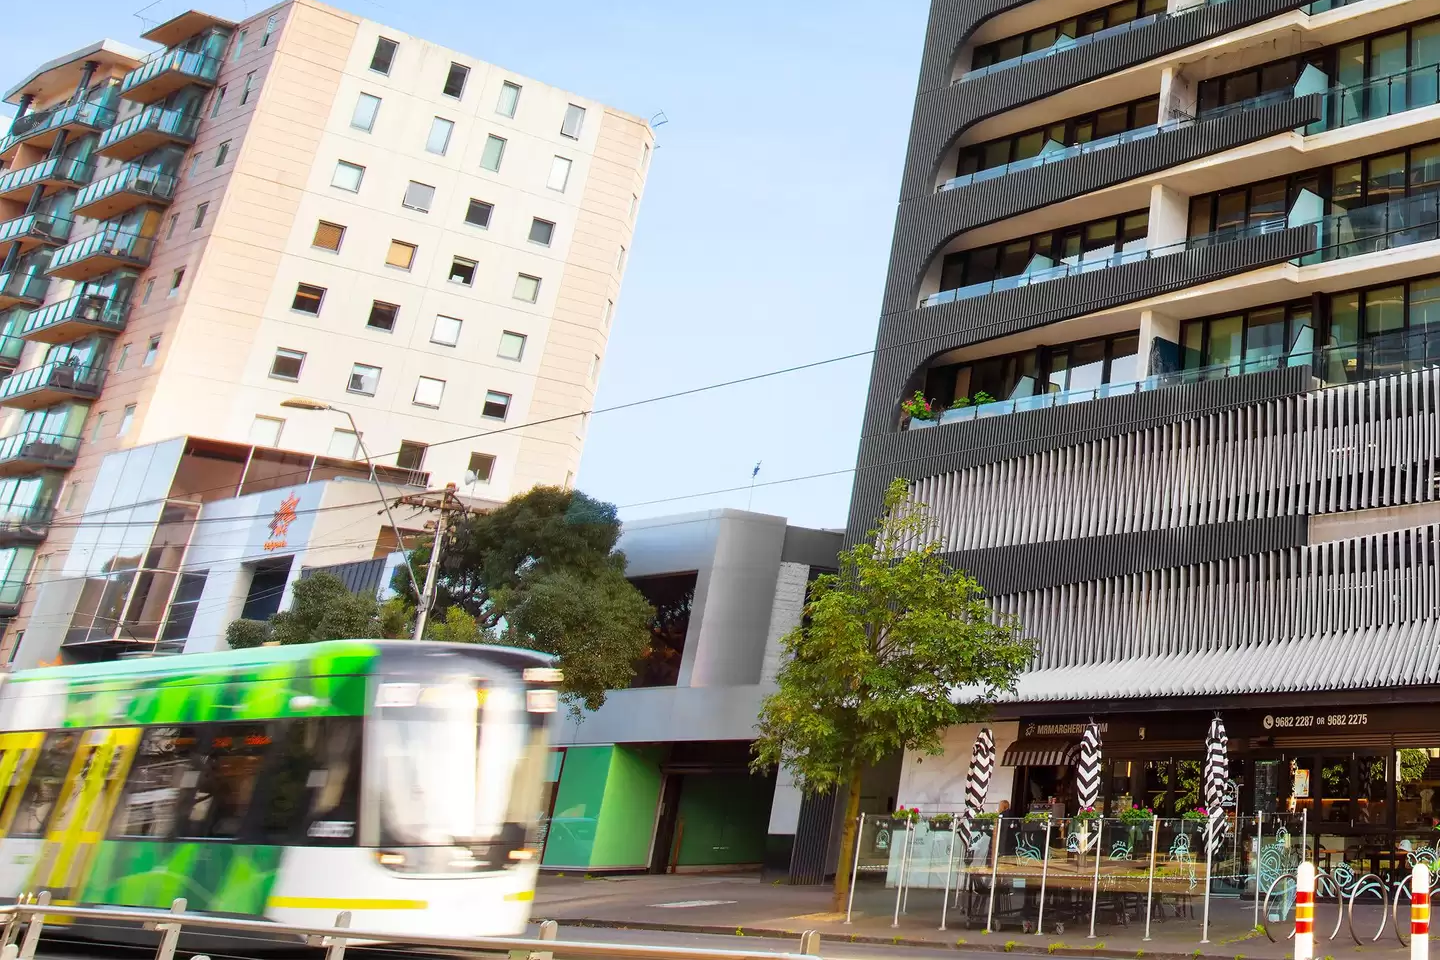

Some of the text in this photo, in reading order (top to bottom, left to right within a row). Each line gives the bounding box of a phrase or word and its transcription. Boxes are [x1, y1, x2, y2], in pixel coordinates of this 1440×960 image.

[1275, 714, 1368, 728] 9682 2287 OR 9682 2275
